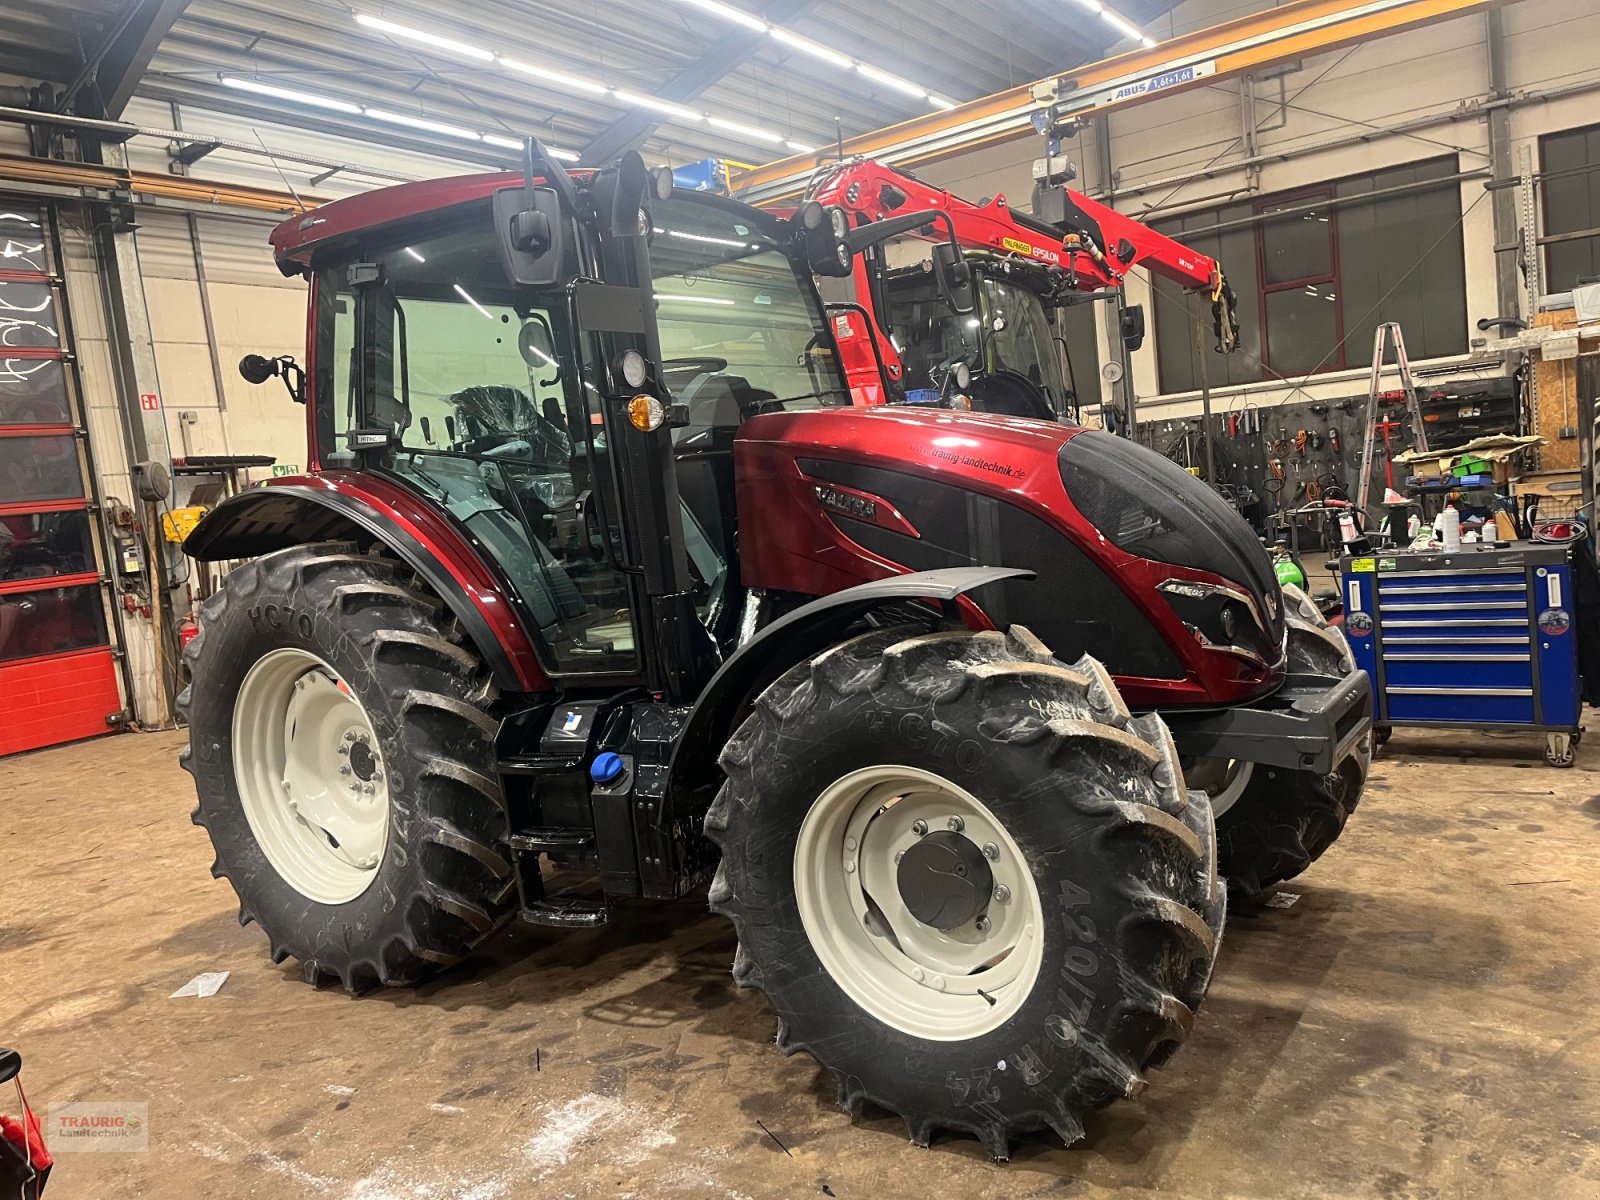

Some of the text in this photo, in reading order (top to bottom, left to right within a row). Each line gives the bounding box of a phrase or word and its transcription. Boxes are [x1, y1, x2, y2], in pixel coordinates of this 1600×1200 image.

[1116, 83, 1146, 99] ABUS
[1032, 246, 1059, 263] EPSILON
[1045, 879, 1100, 1049] 420/70
